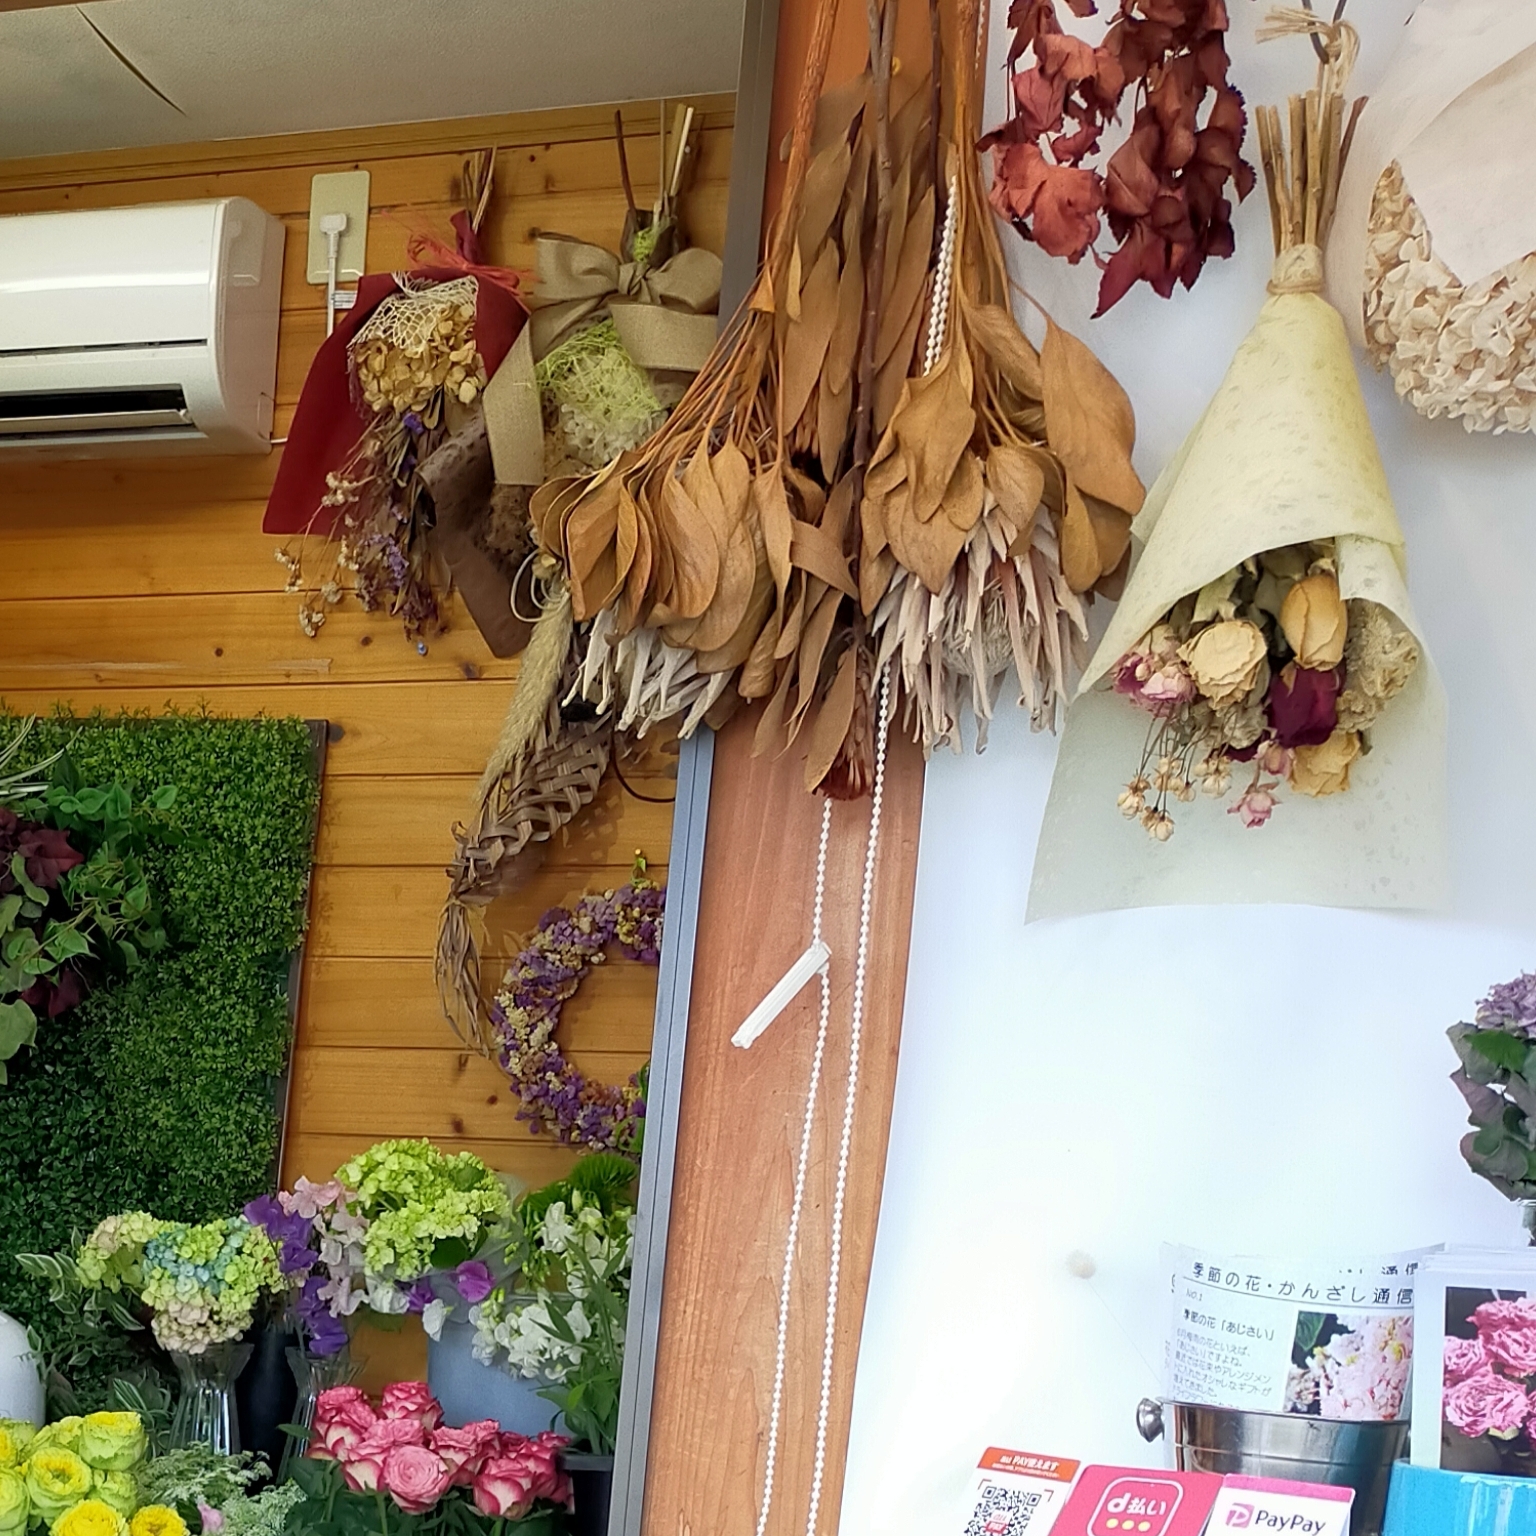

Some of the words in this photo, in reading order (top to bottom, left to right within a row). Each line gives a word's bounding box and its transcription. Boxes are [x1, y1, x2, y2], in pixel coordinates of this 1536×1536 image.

[1192, 1261, 1414, 1305] 季節の花・かんざし通信
[1106, 1492, 1167, 1516] d払い
[1254, 1509, 1327, 1536] PayPay
